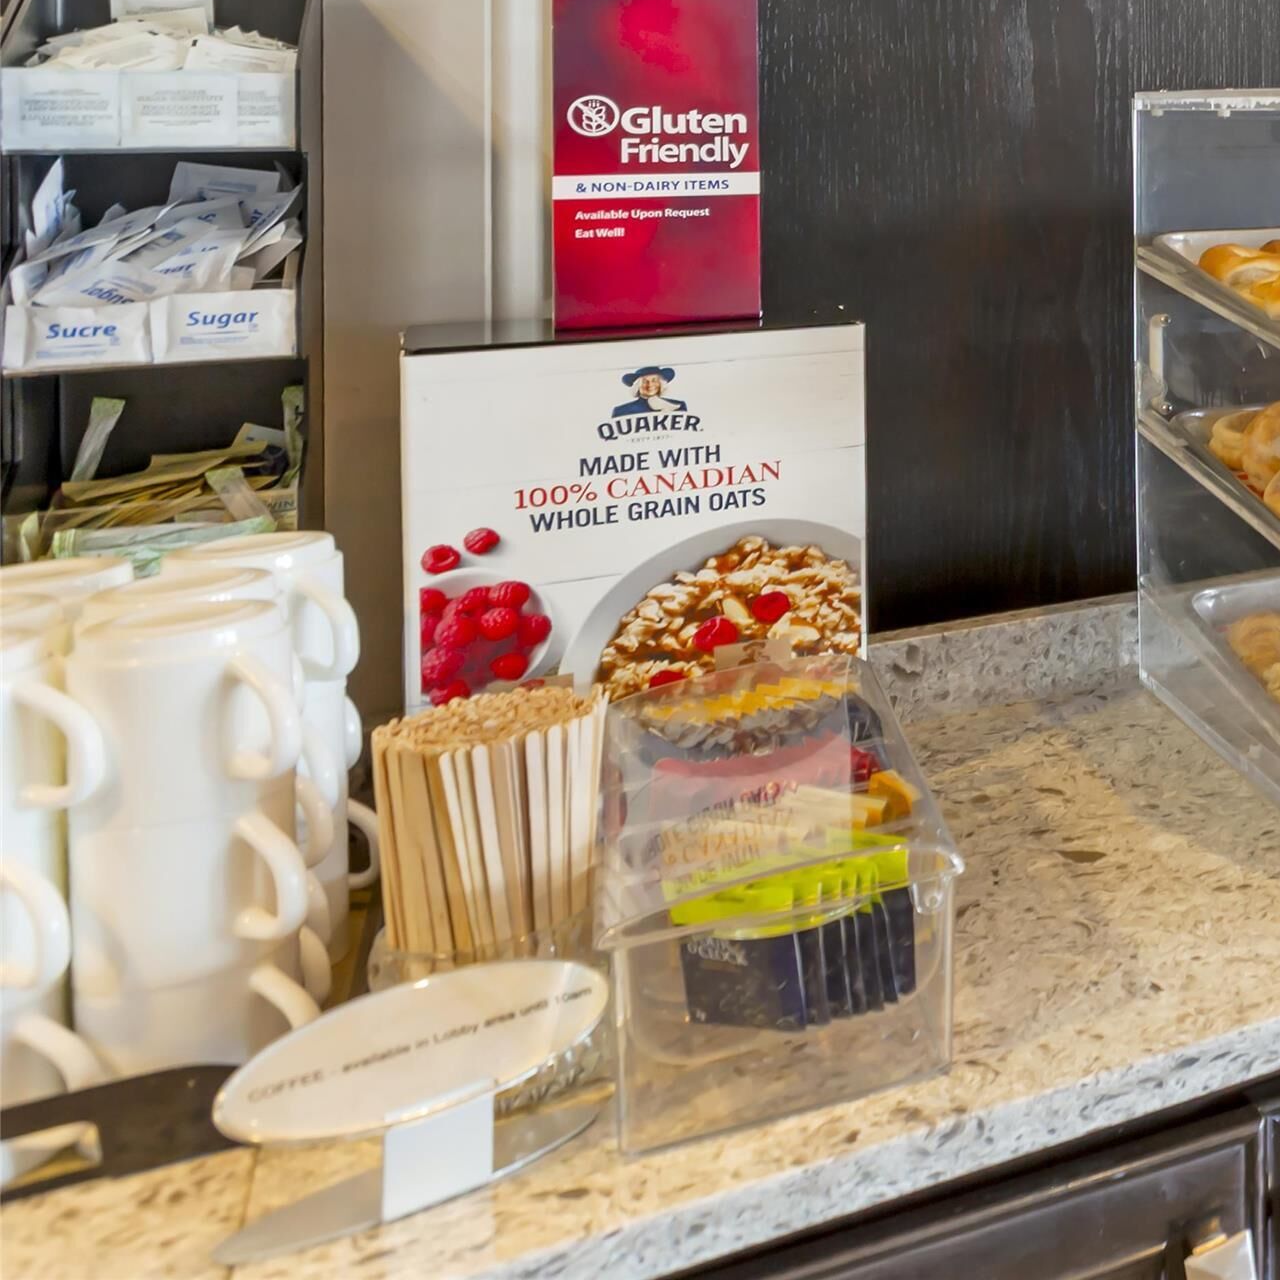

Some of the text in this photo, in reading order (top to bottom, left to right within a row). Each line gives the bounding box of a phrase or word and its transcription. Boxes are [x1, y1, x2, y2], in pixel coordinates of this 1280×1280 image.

[620, 106, 748, 135] Gluten
[621, 136, 750, 169] Friendly
[576, 179, 729, 193] & NON-DAIRY ITEMS
[575, 207, 710, 221] Available Upon Request
[575, 228, 625, 239] Eat Well!
[46, 323, 117, 340] Sucre
[186, 311, 259, 329] Sugar
[597, 414, 701, 442] QUAKER
[579, 444, 721, 477] MADE WITH
[513, 460, 782, 510] 100% CANADIAN
[529, 487, 766, 533] WHOLE GRAIN OATS
[248, 1072, 325, 1104] COFFEE
[341, 1042, 412, 1073] available
[415, 1038, 429, 1051] in
[433, 1023, 480, 1046] Lobby
[484, 1011, 516, 1029] area
[519, 998, 549, 1017] until
[555, 986, 593, 1005] 10am
